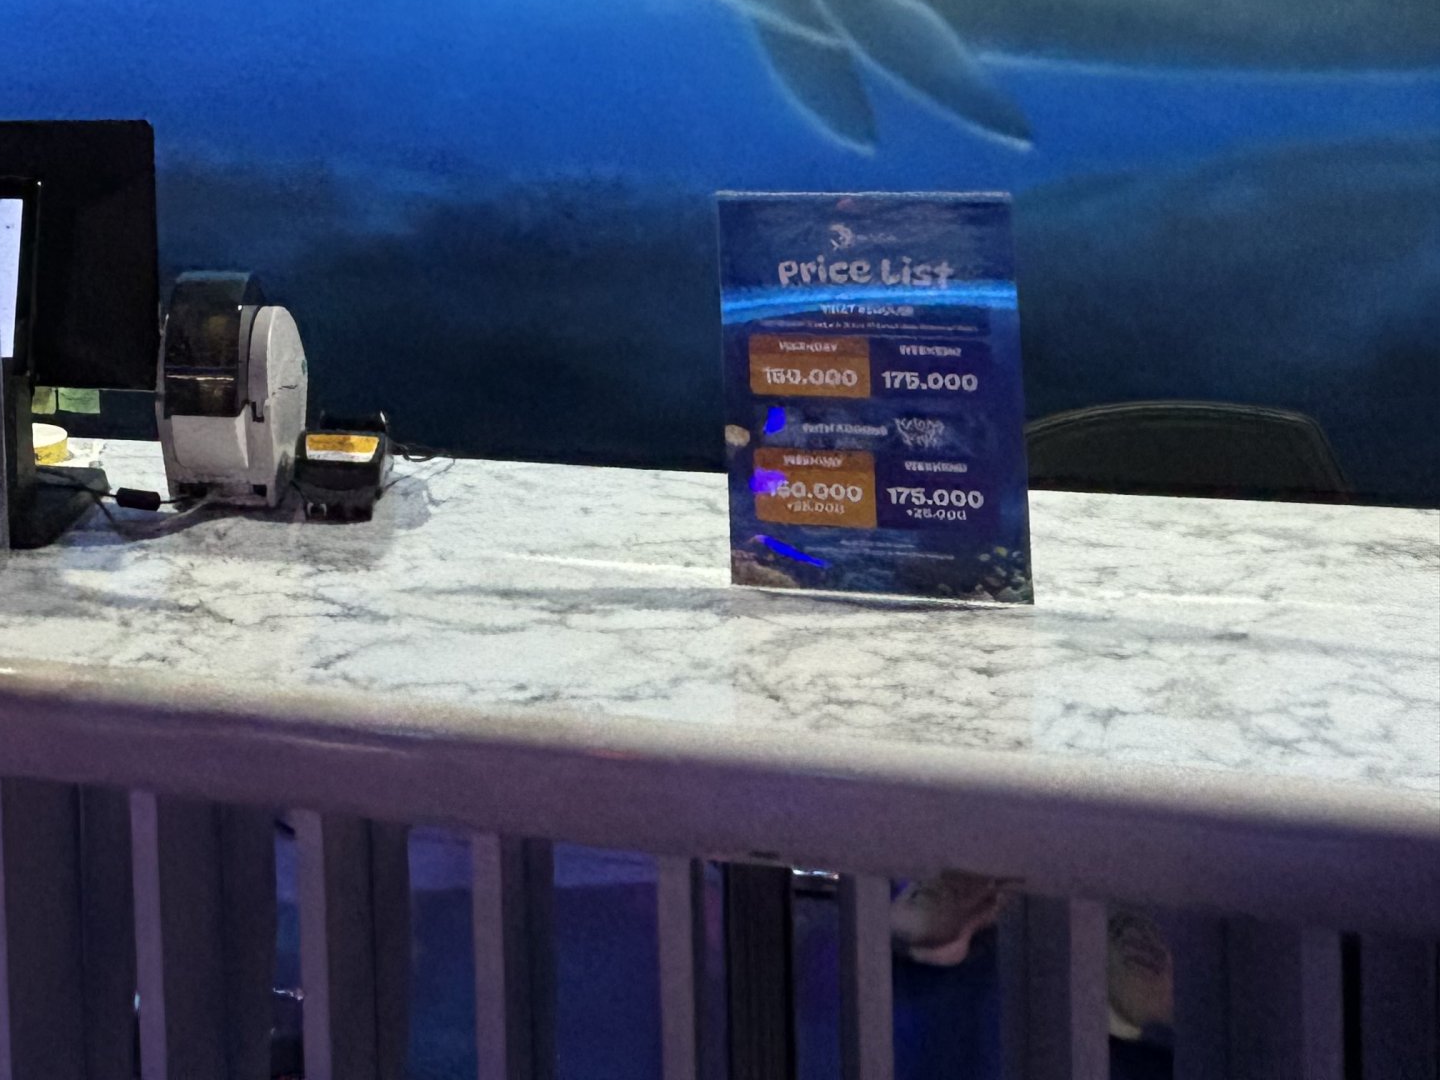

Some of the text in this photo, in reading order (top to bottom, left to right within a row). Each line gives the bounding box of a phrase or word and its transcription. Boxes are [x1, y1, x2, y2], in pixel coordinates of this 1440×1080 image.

[777, 255, 954, 290] Price List
[881, 370, 979, 392] 175.000
[886, 486, 985, 510] 175.000
